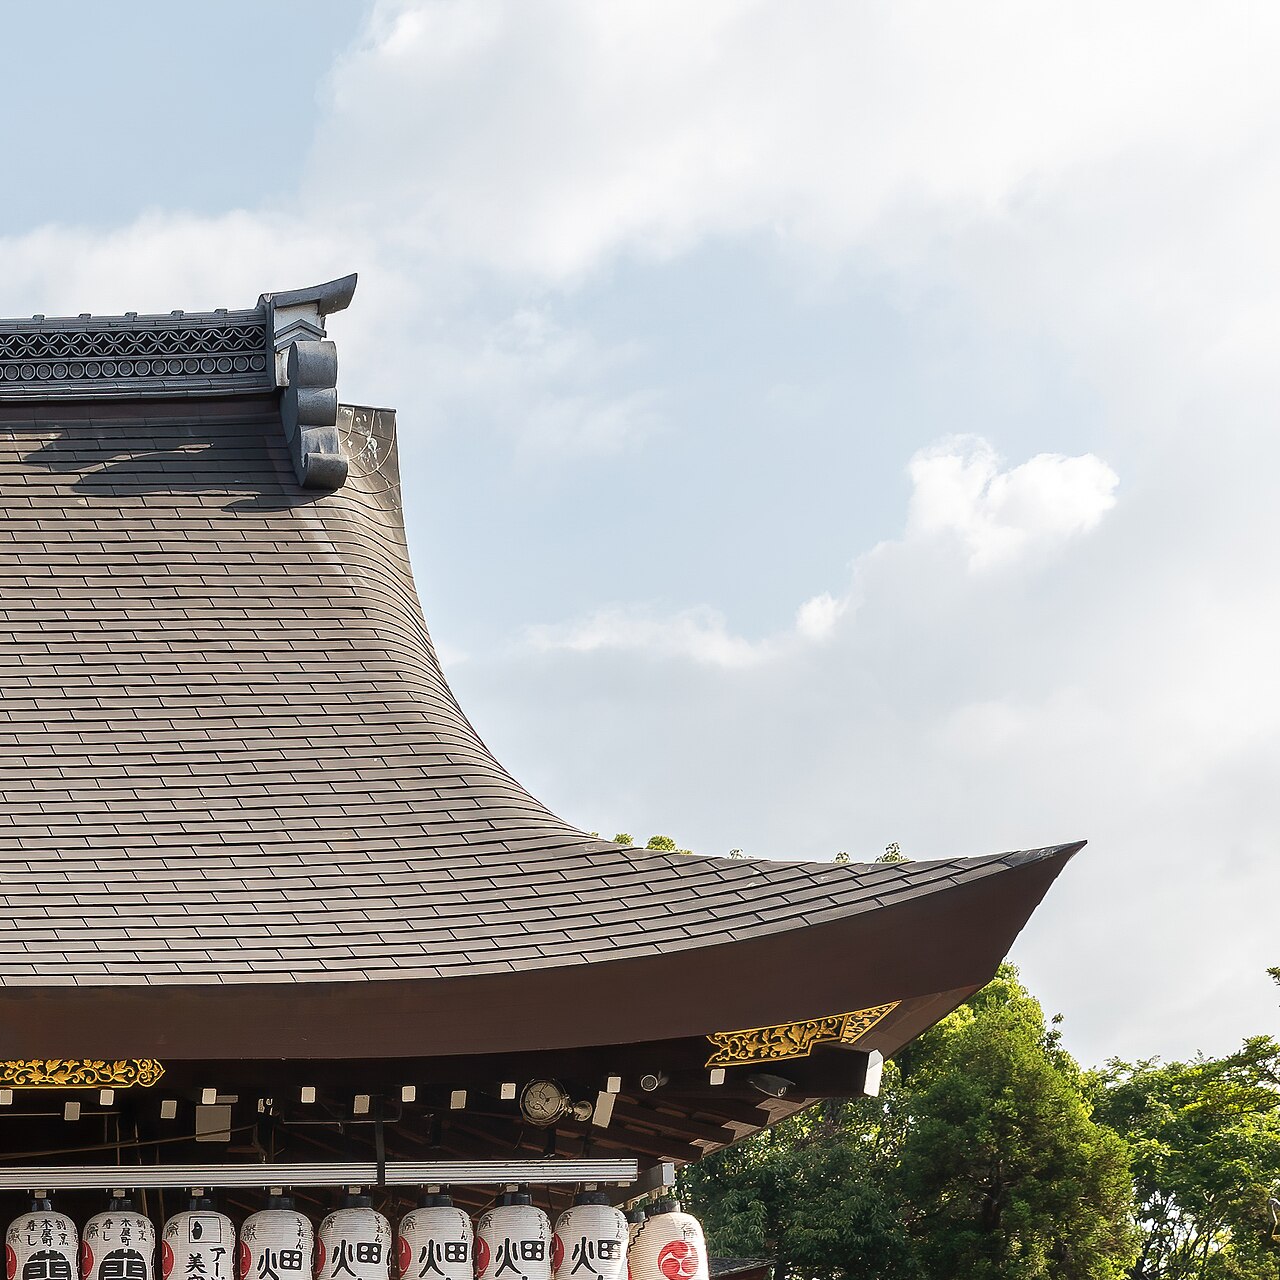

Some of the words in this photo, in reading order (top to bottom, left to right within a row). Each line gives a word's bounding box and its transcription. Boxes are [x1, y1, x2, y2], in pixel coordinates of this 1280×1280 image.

[40, 1219, 53, 1246] 木屋町
[120, 1219, 132, 1246] 木屋町
